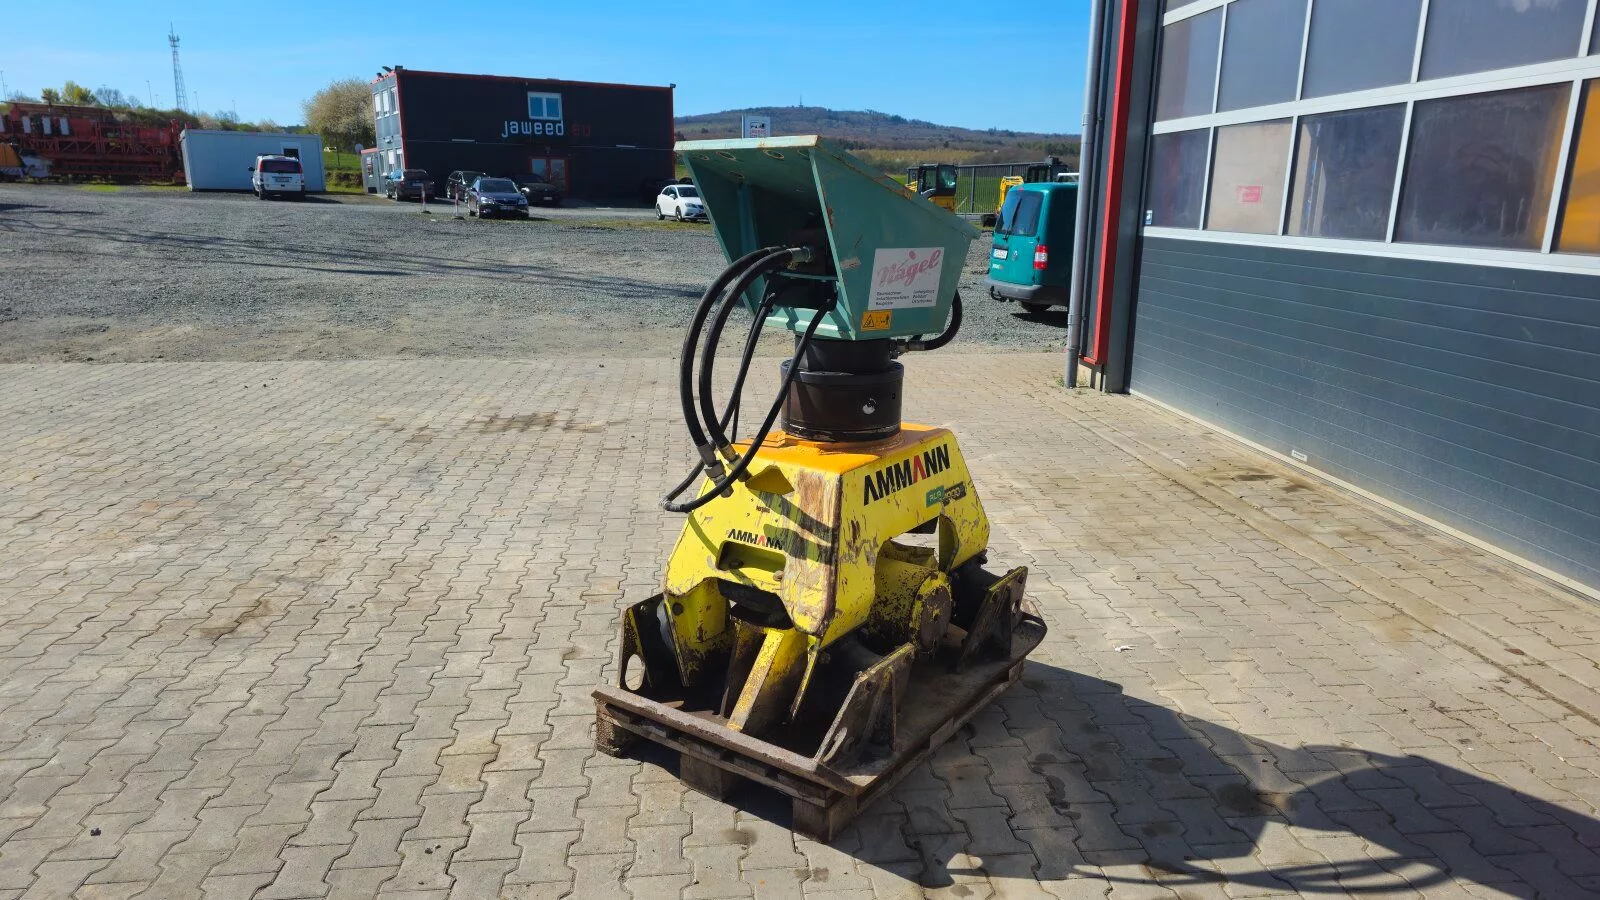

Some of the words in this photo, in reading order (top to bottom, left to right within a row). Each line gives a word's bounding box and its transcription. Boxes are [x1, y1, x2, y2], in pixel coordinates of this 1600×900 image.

[501, 120, 564, 138] jaweed
[863, 443, 951, 507] AMMANN
[728, 529, 782, 550] AMMANN
